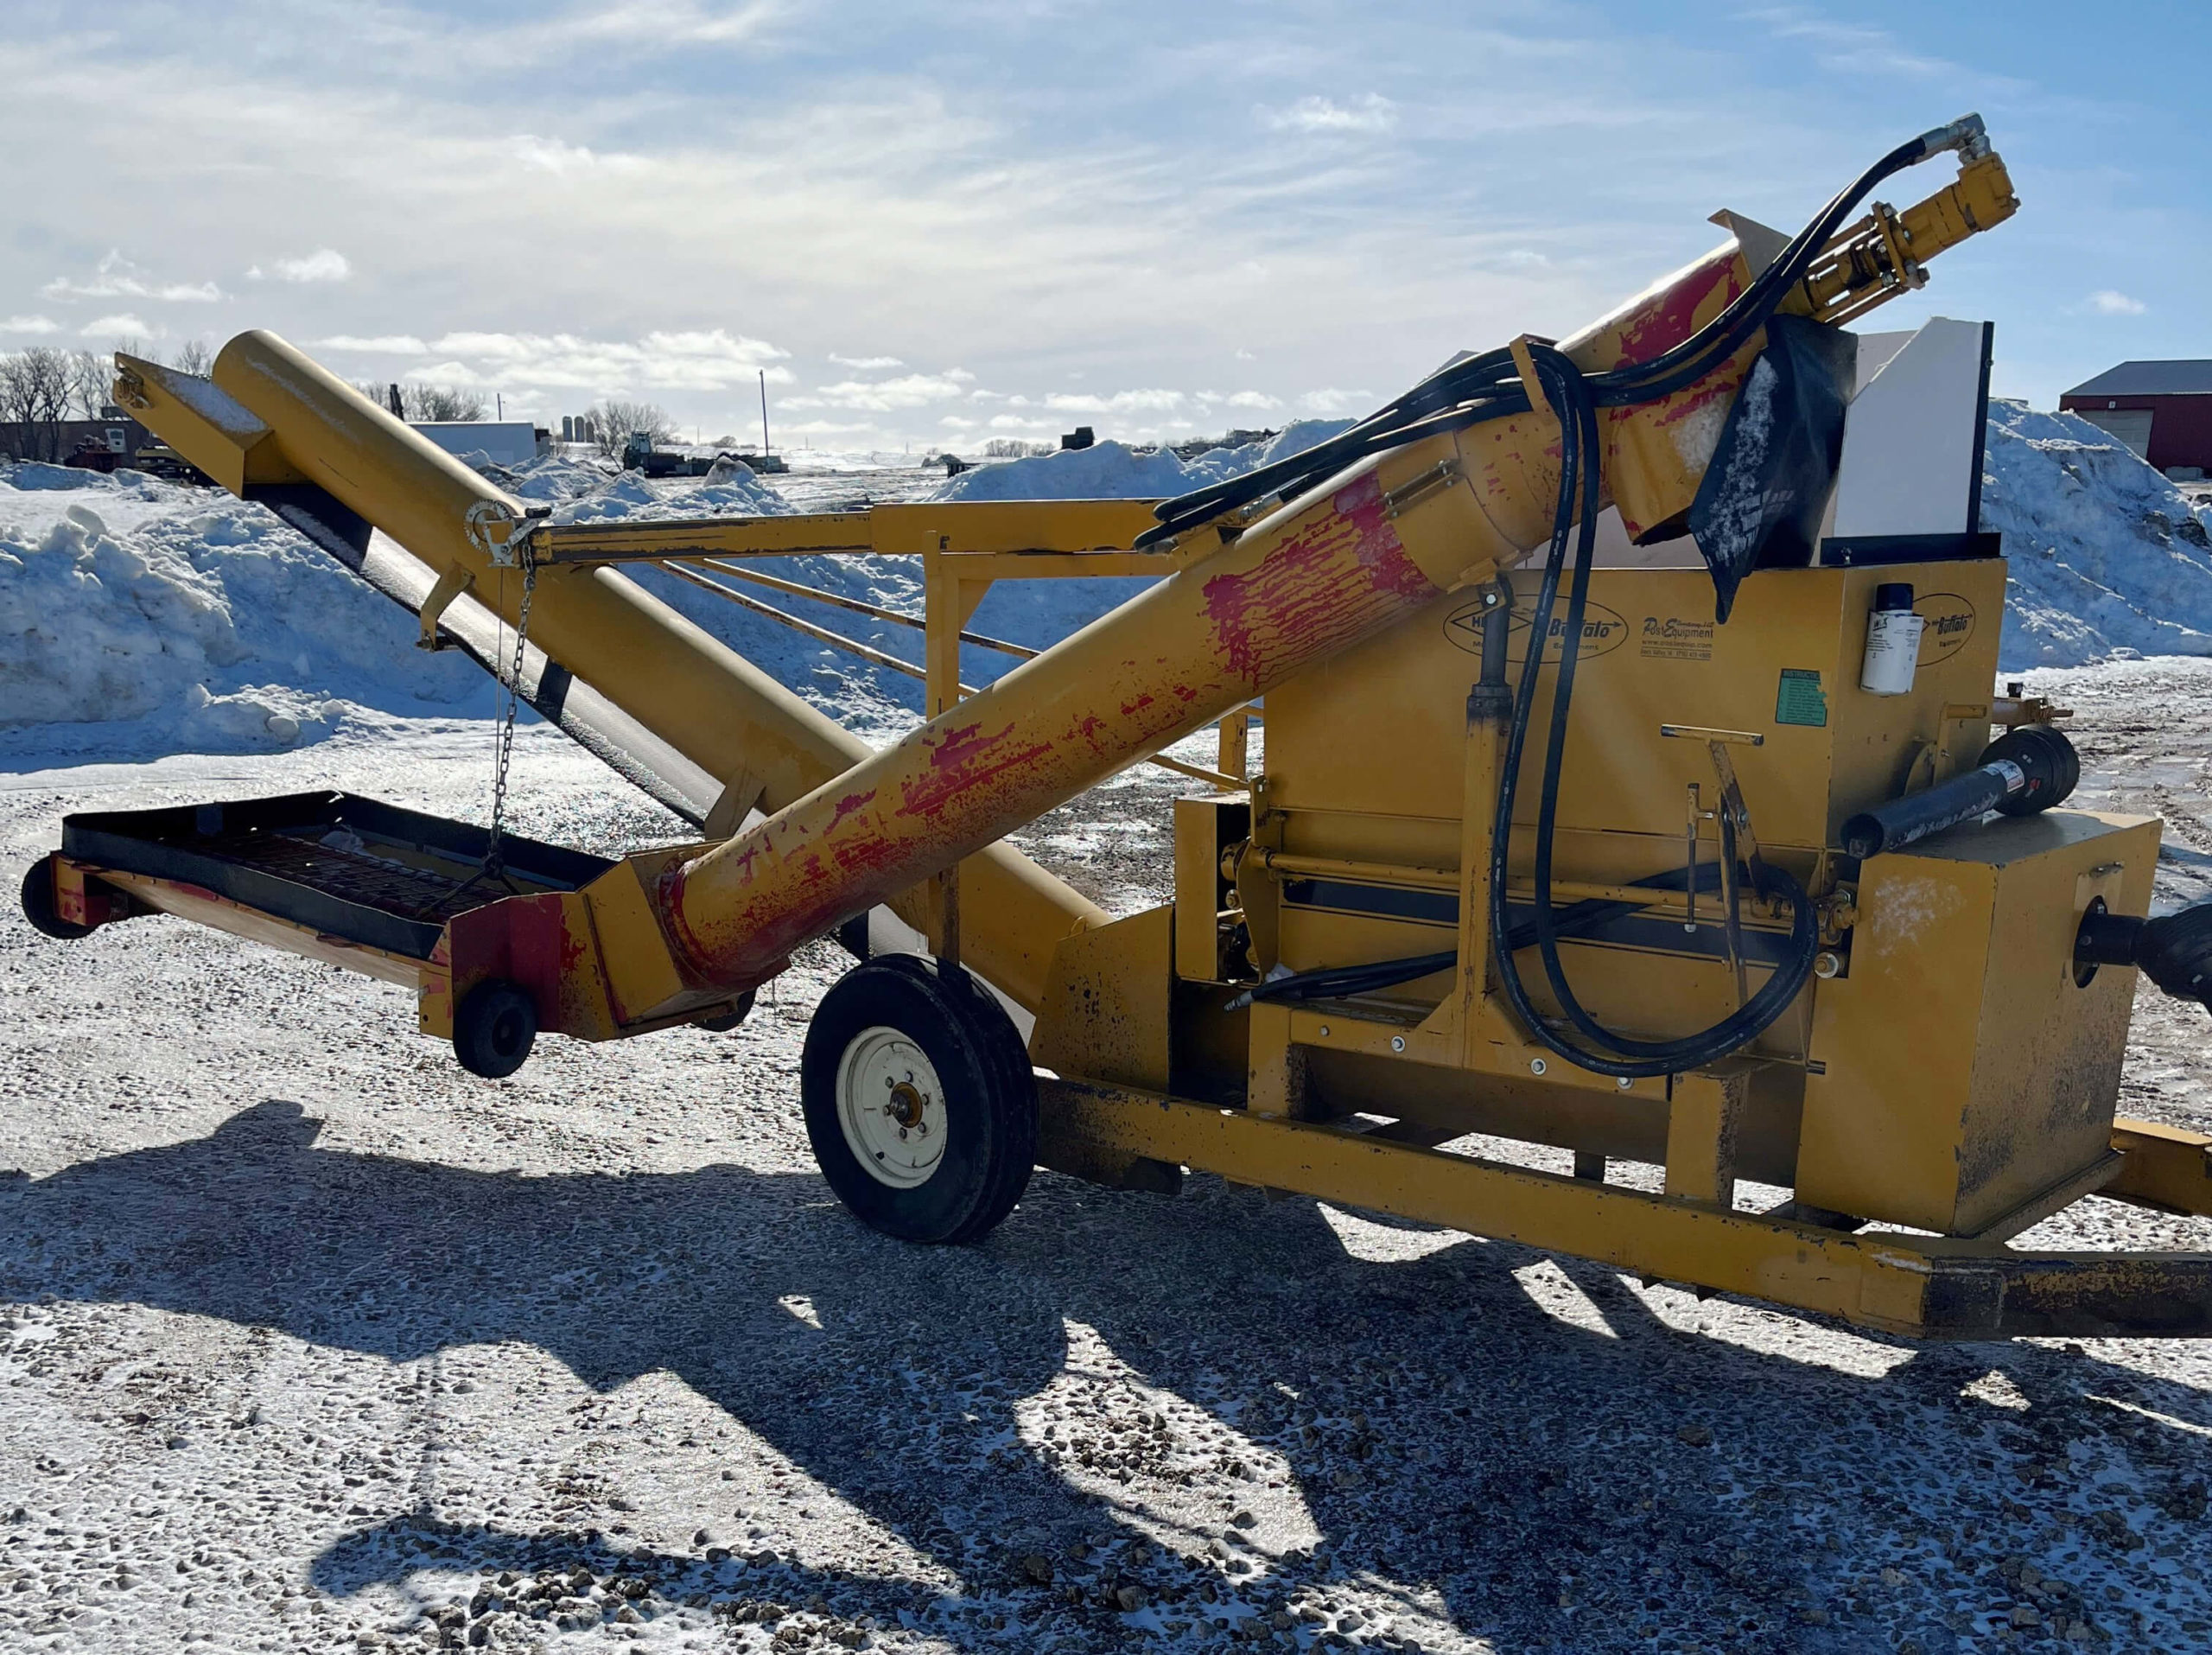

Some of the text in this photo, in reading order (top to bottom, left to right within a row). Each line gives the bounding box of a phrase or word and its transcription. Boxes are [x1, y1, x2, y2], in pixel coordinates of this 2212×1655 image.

[1548, 618, 1610, 638] Balo
[1662, 618, 1713, 640] Equipment
[1937, 614, 1967, 635] Buffalo
